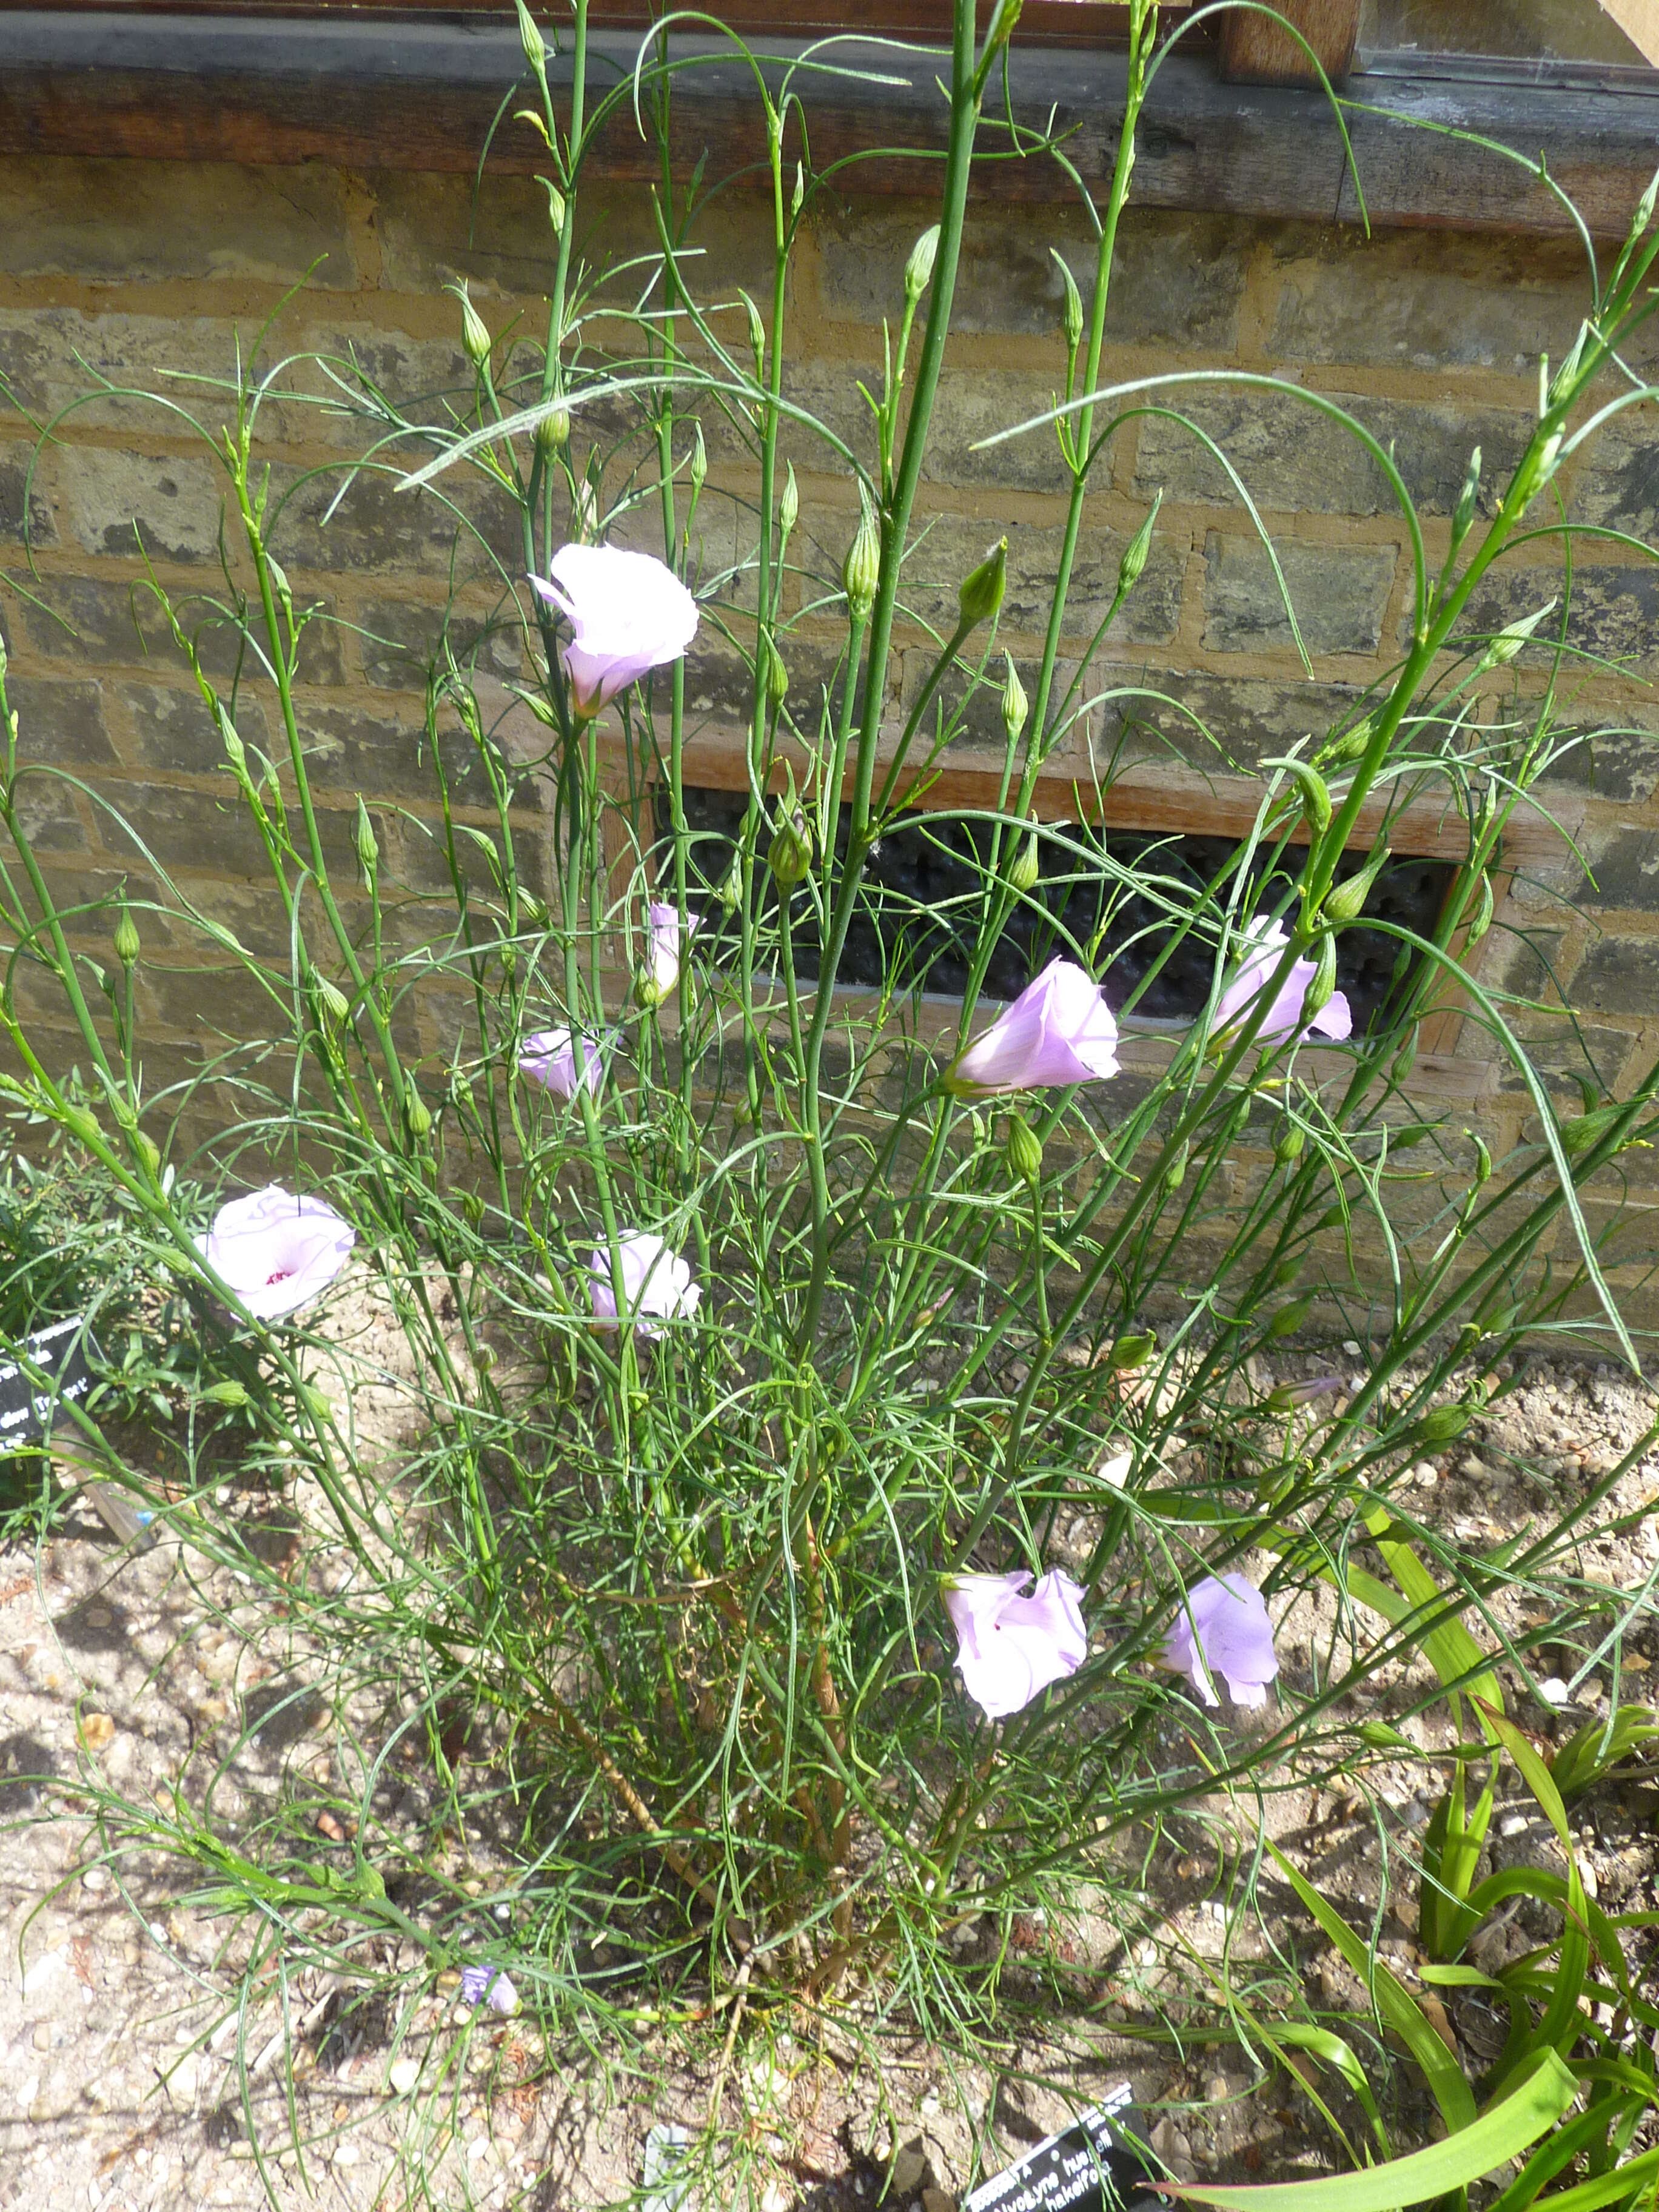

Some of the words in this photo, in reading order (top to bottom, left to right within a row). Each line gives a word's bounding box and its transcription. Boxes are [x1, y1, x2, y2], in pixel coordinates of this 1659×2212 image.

[34, 1376, 88, 1412] Trpet'
[994, 2172, 1059, 2212] lyogyne
[1045, 2160, 1112, 2212] hakeifoa
